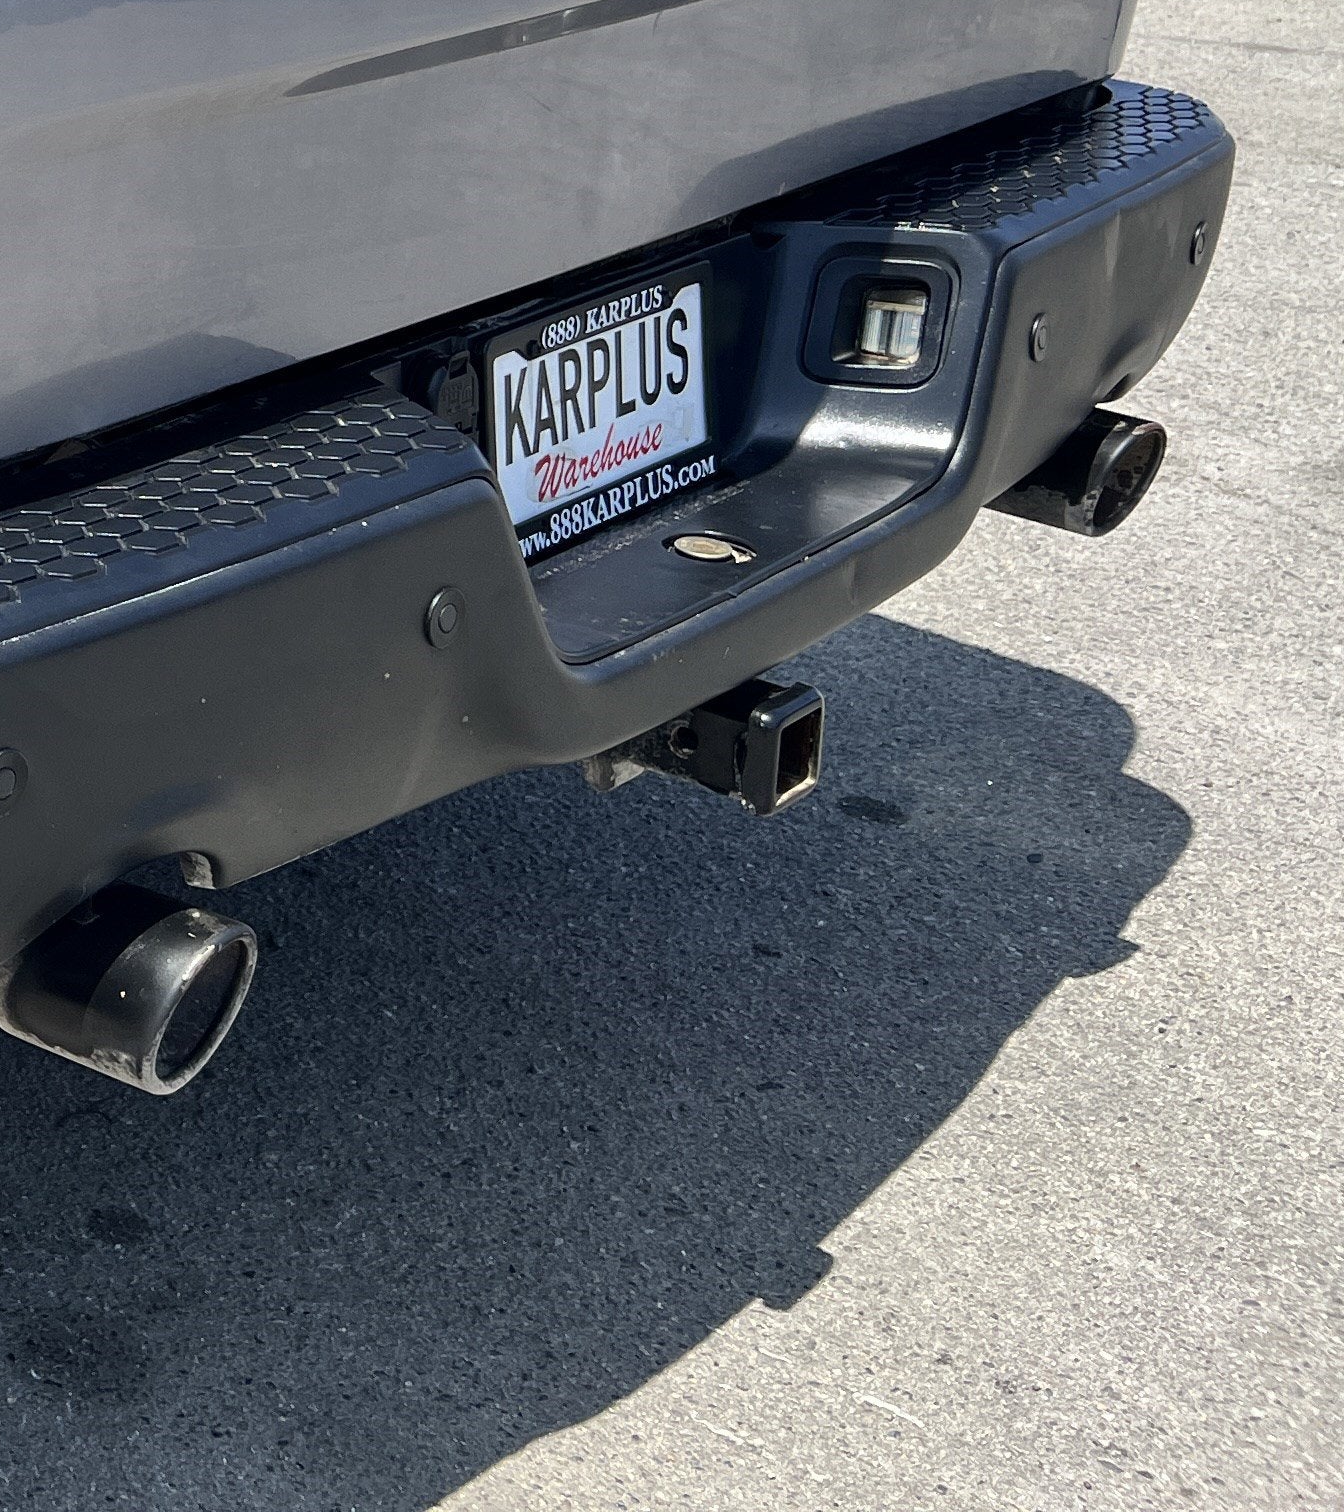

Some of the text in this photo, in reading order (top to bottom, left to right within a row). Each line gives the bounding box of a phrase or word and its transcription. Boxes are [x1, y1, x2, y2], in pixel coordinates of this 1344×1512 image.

[541, 285, 663, 349] (888) KARPLUS
[504, 307, 688, 467] KARPLUS
[534, 422, 663, 504] Warehouse
